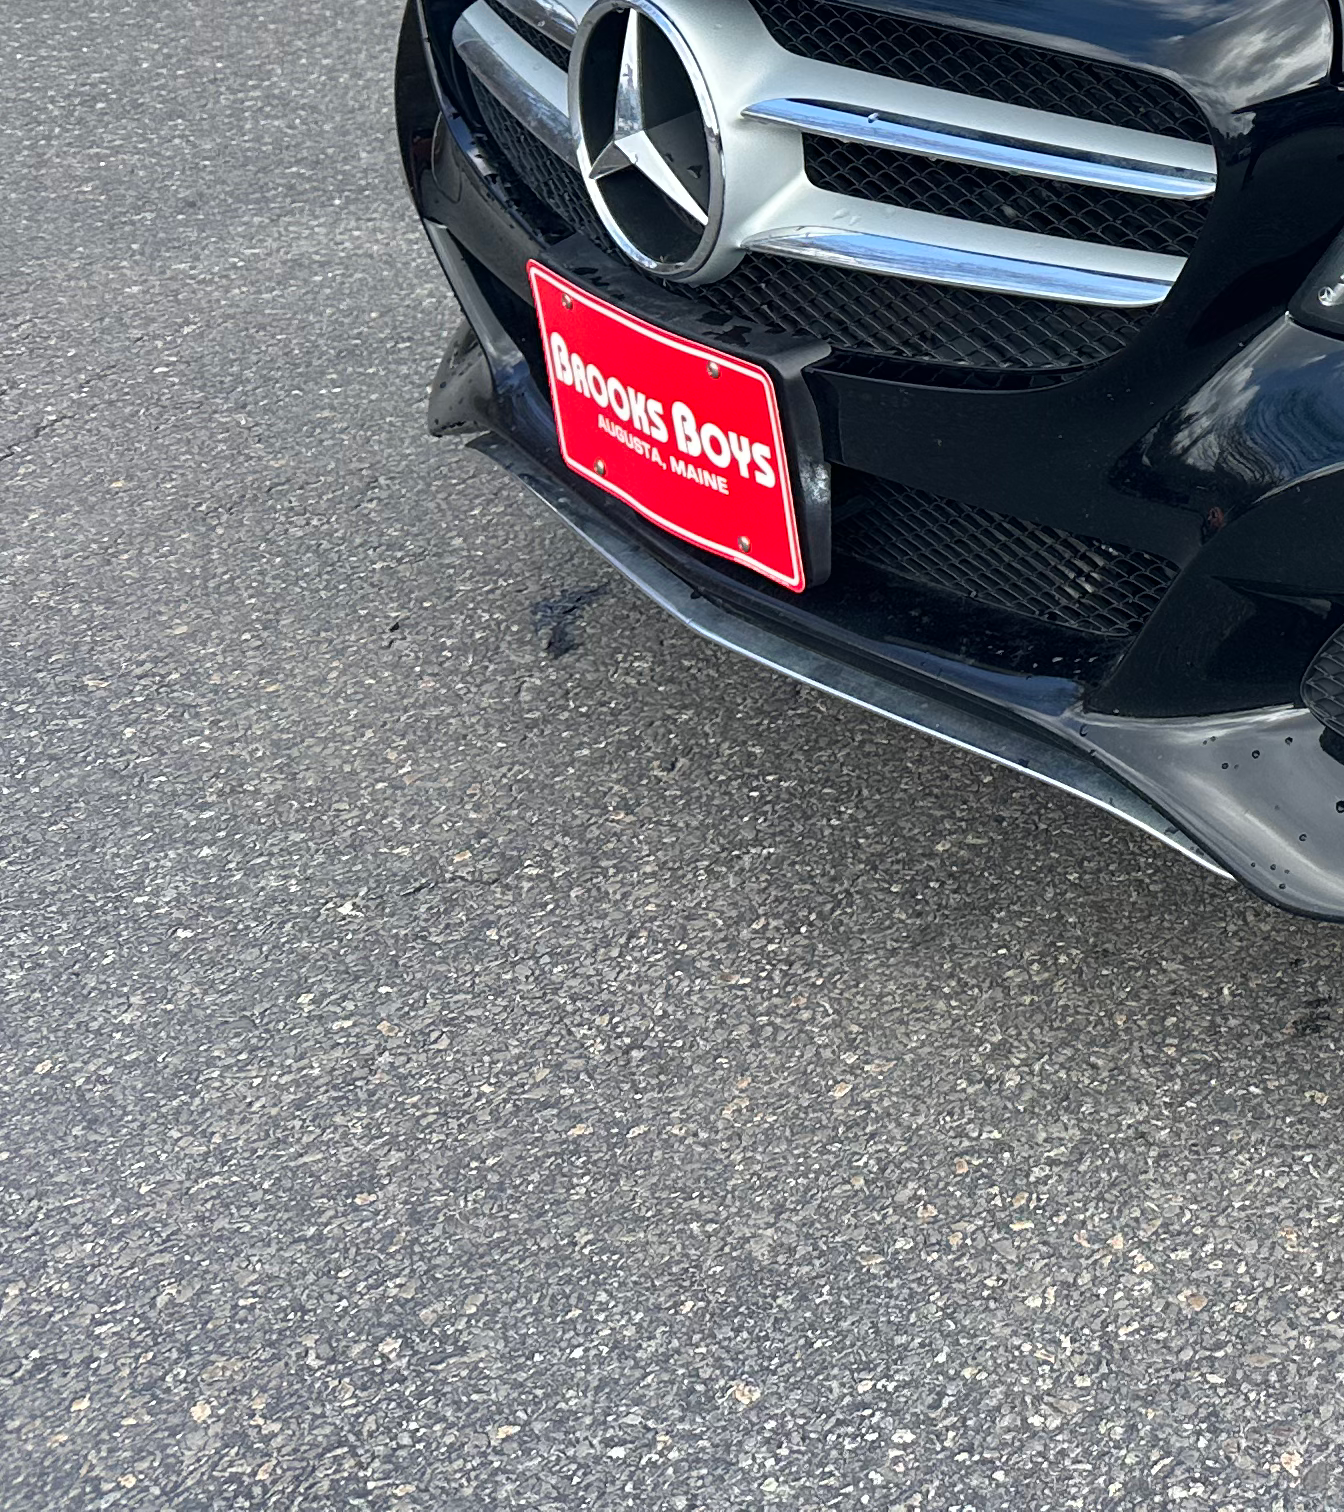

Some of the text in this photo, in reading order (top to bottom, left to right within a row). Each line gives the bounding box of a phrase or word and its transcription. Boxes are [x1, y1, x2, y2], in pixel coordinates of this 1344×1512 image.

[550, 331, 776, 489] BROOKS BOYS
[597, 413, 730, 495] AUGUSTA, MAINE
